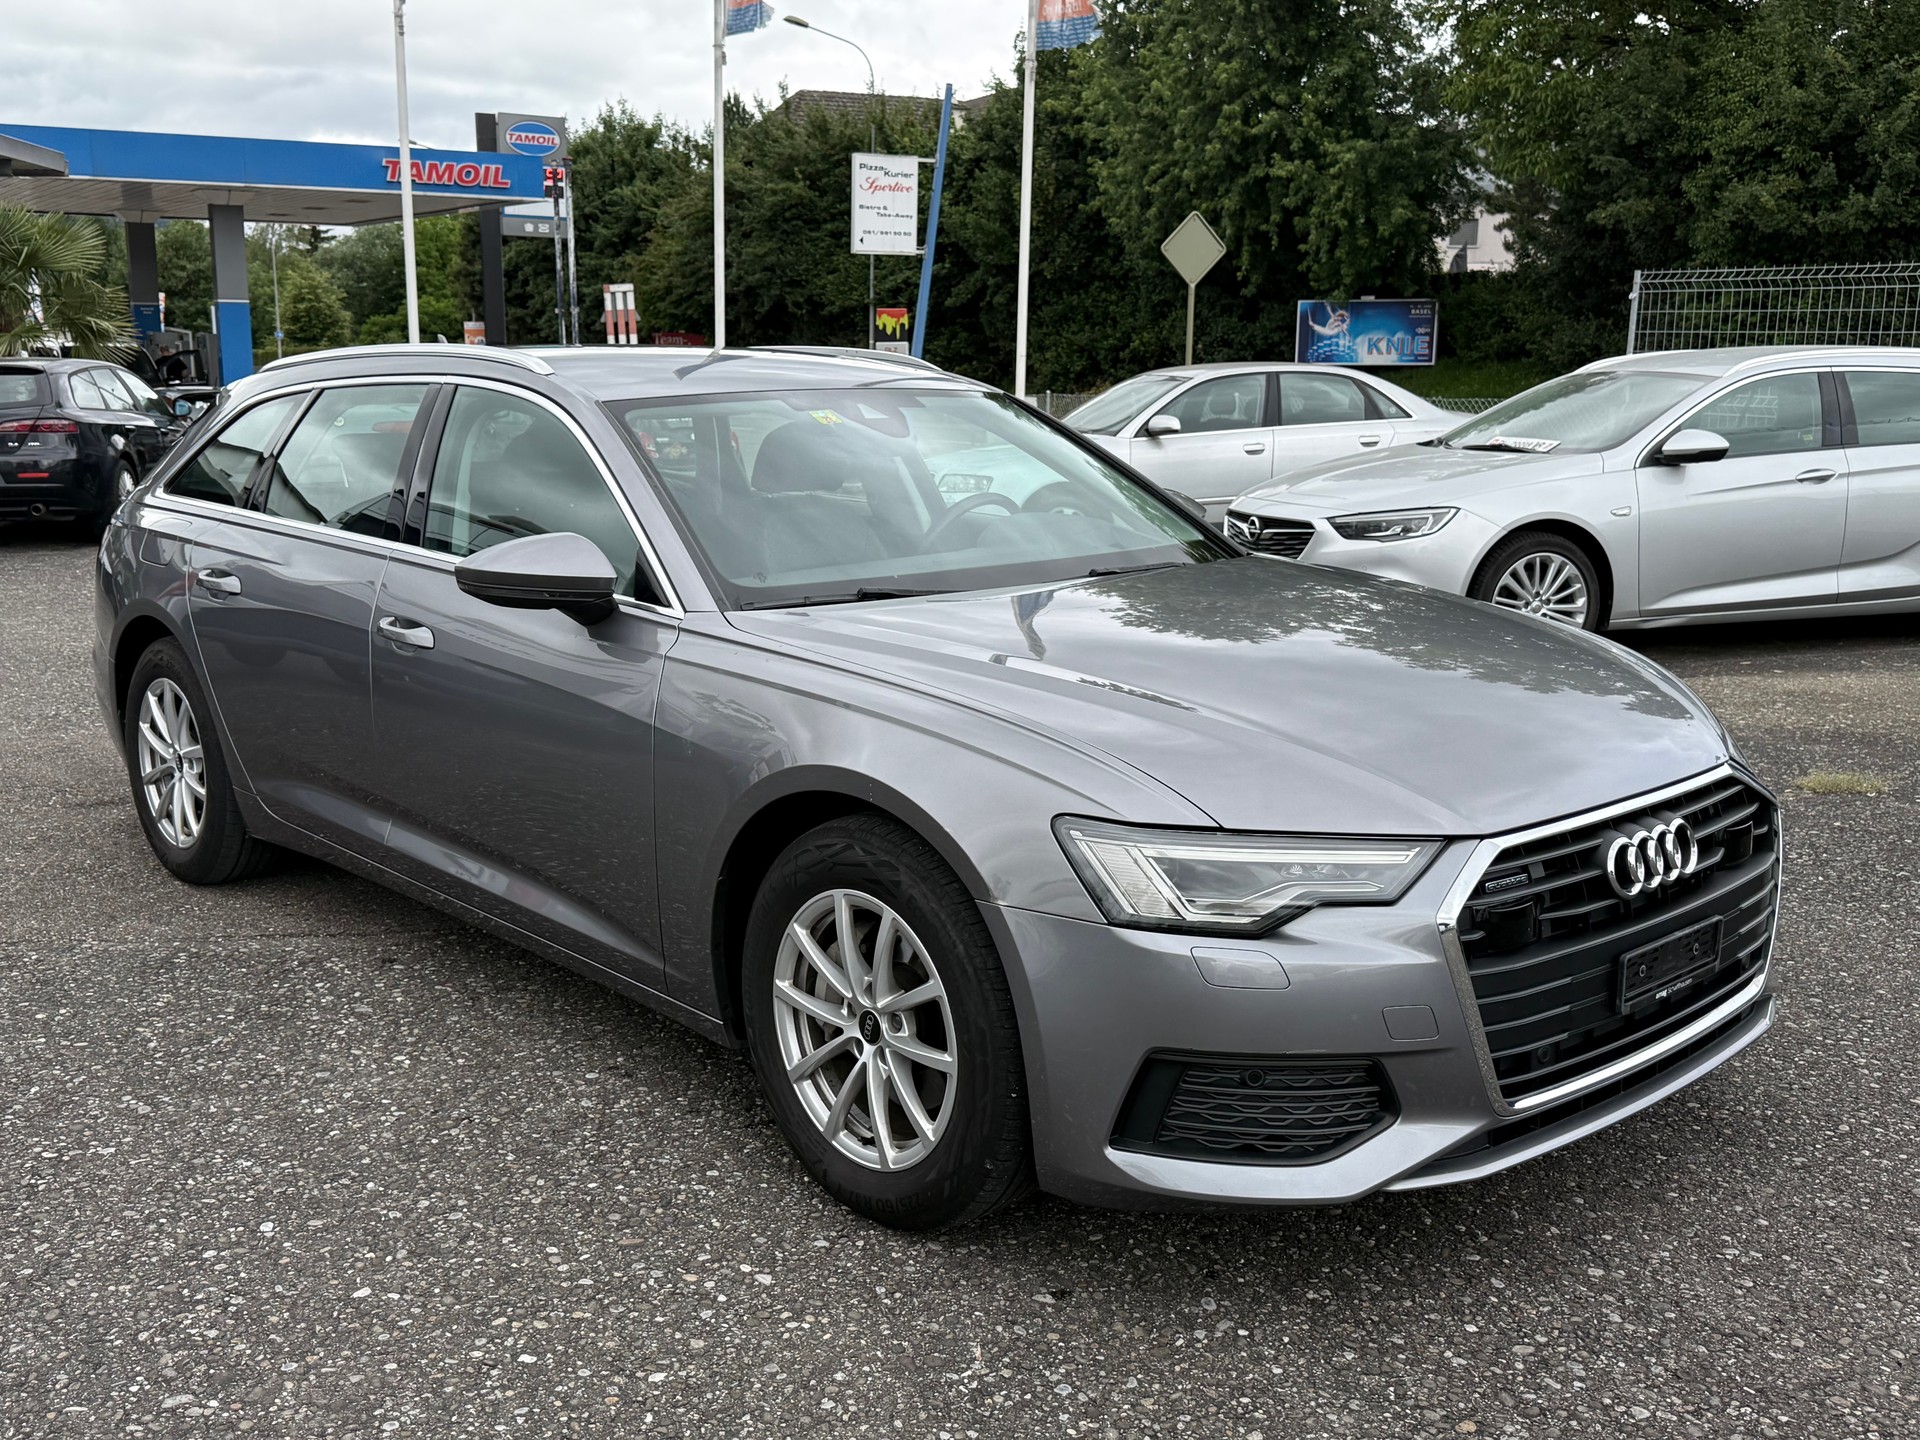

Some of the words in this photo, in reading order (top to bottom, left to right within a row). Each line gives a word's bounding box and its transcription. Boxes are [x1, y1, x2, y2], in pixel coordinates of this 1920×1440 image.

[507, 133, 559, 146] TAMOIL
[383, 158, 511, 188] TAMOIL
[859, 163, 888, 171] Pizza-
[859, 177, 914, 195] Sportivo
[1367, 336, 1430, 355] KNIE
[1488, 876, 1527, 891] quattro
